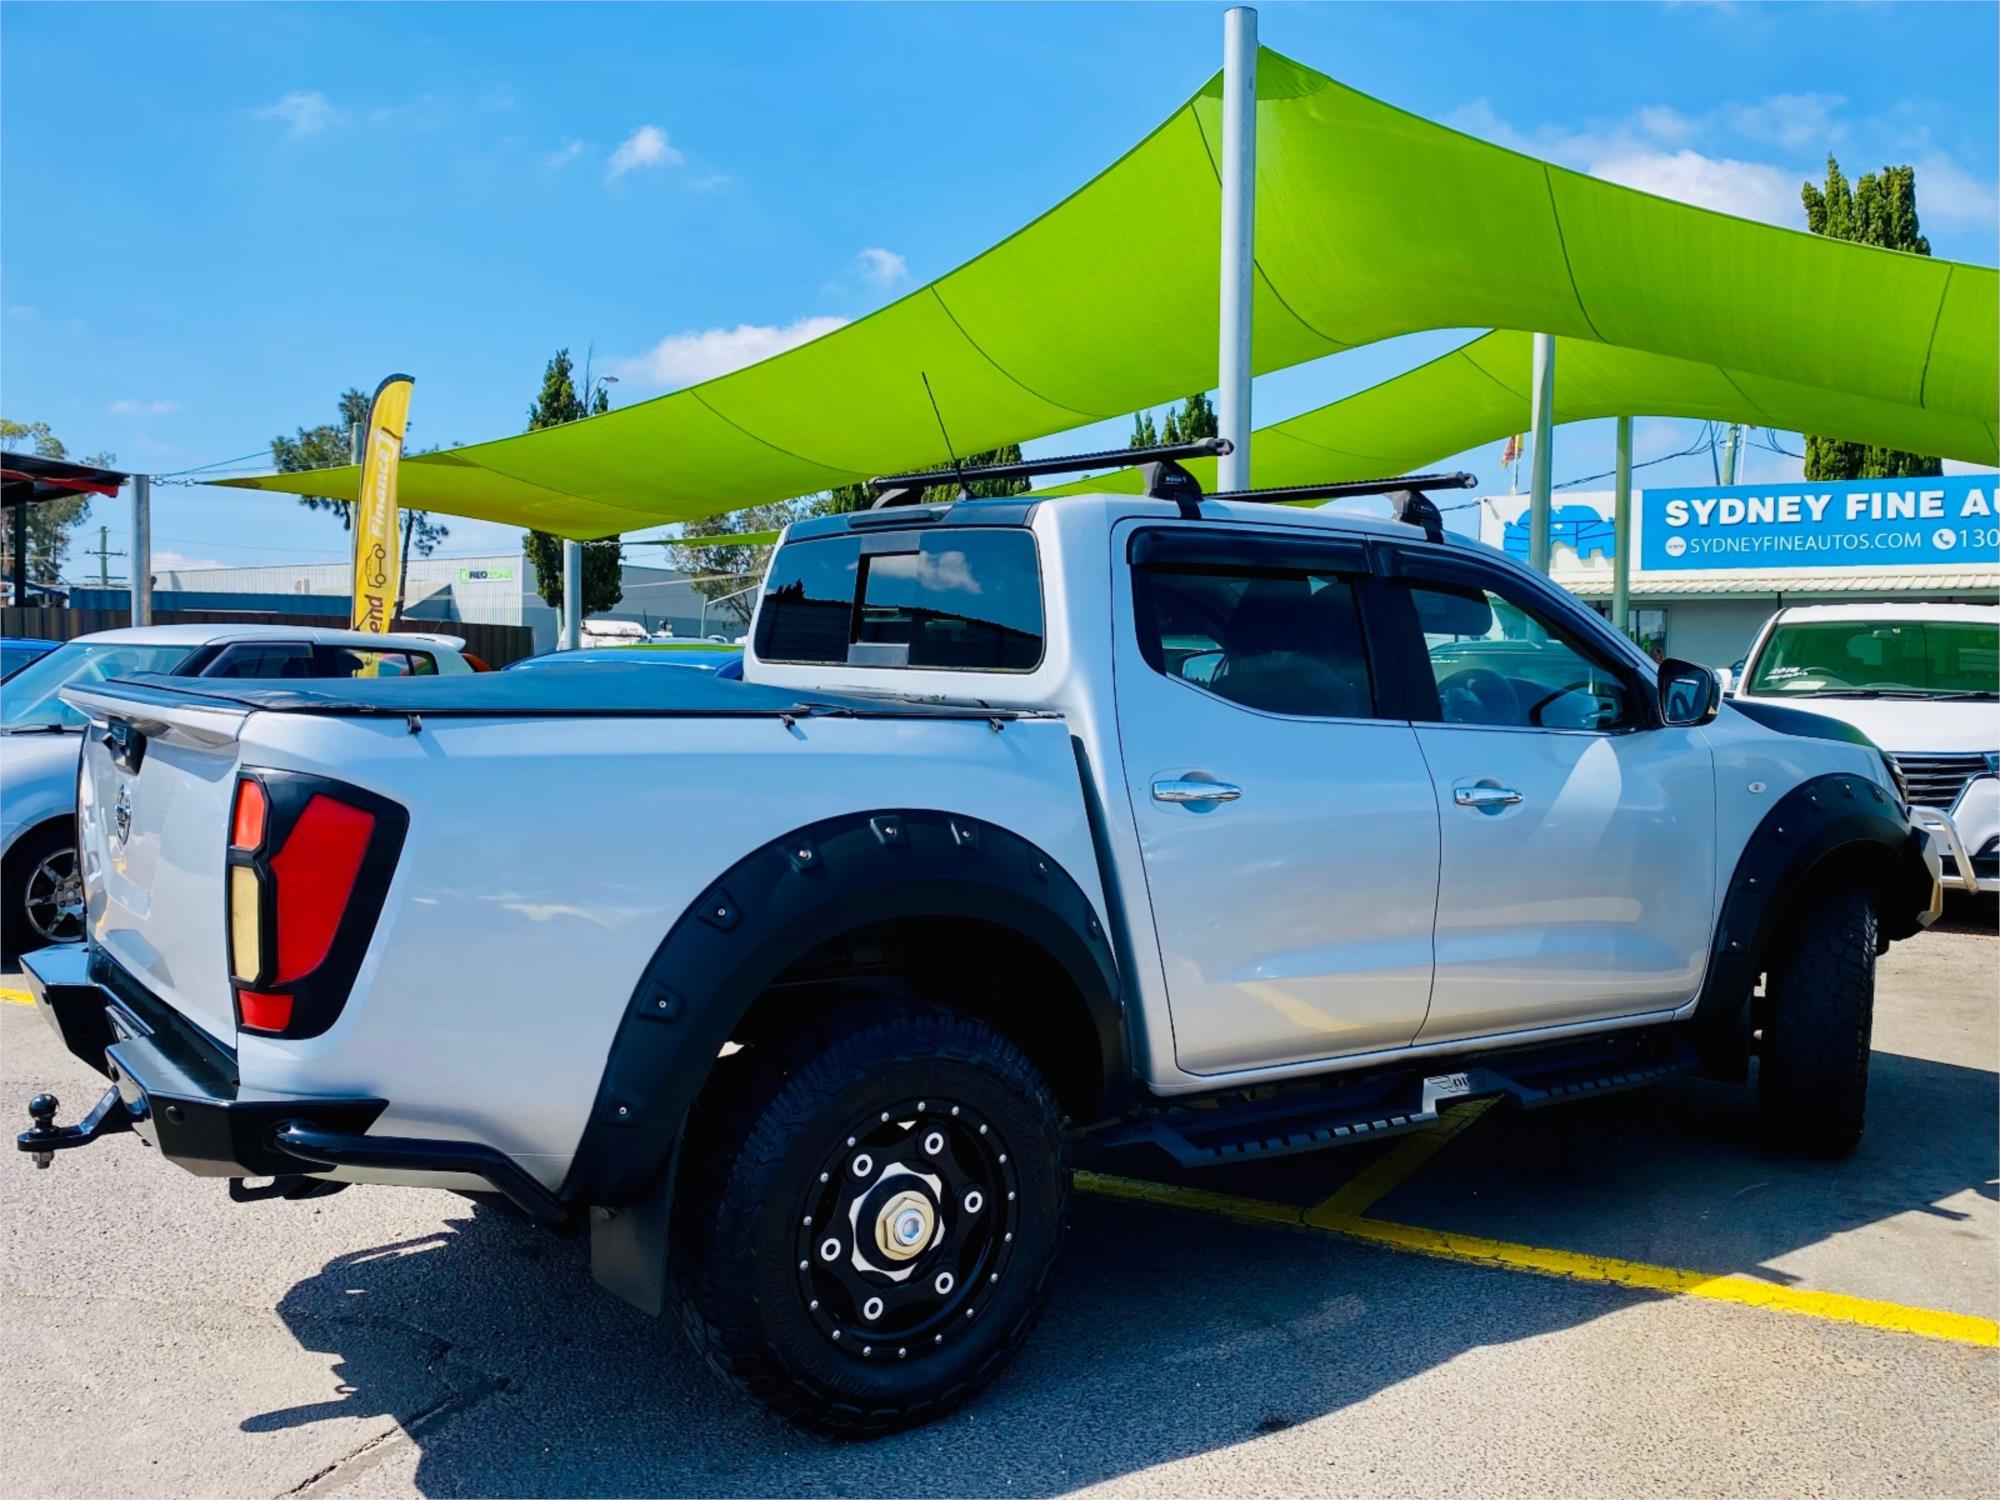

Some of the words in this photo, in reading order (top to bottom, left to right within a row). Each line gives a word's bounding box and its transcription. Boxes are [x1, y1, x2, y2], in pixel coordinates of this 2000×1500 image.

[369, 449, 389, 539] Finance
[1665, 494, 1833, 527] SYDNEY
[1846, 490, 1945, 521] FINE
[1960, 488, 2000, 517] A
[1690, 532, 1921, 554] SYDNEYFINEAUTOS.COM
